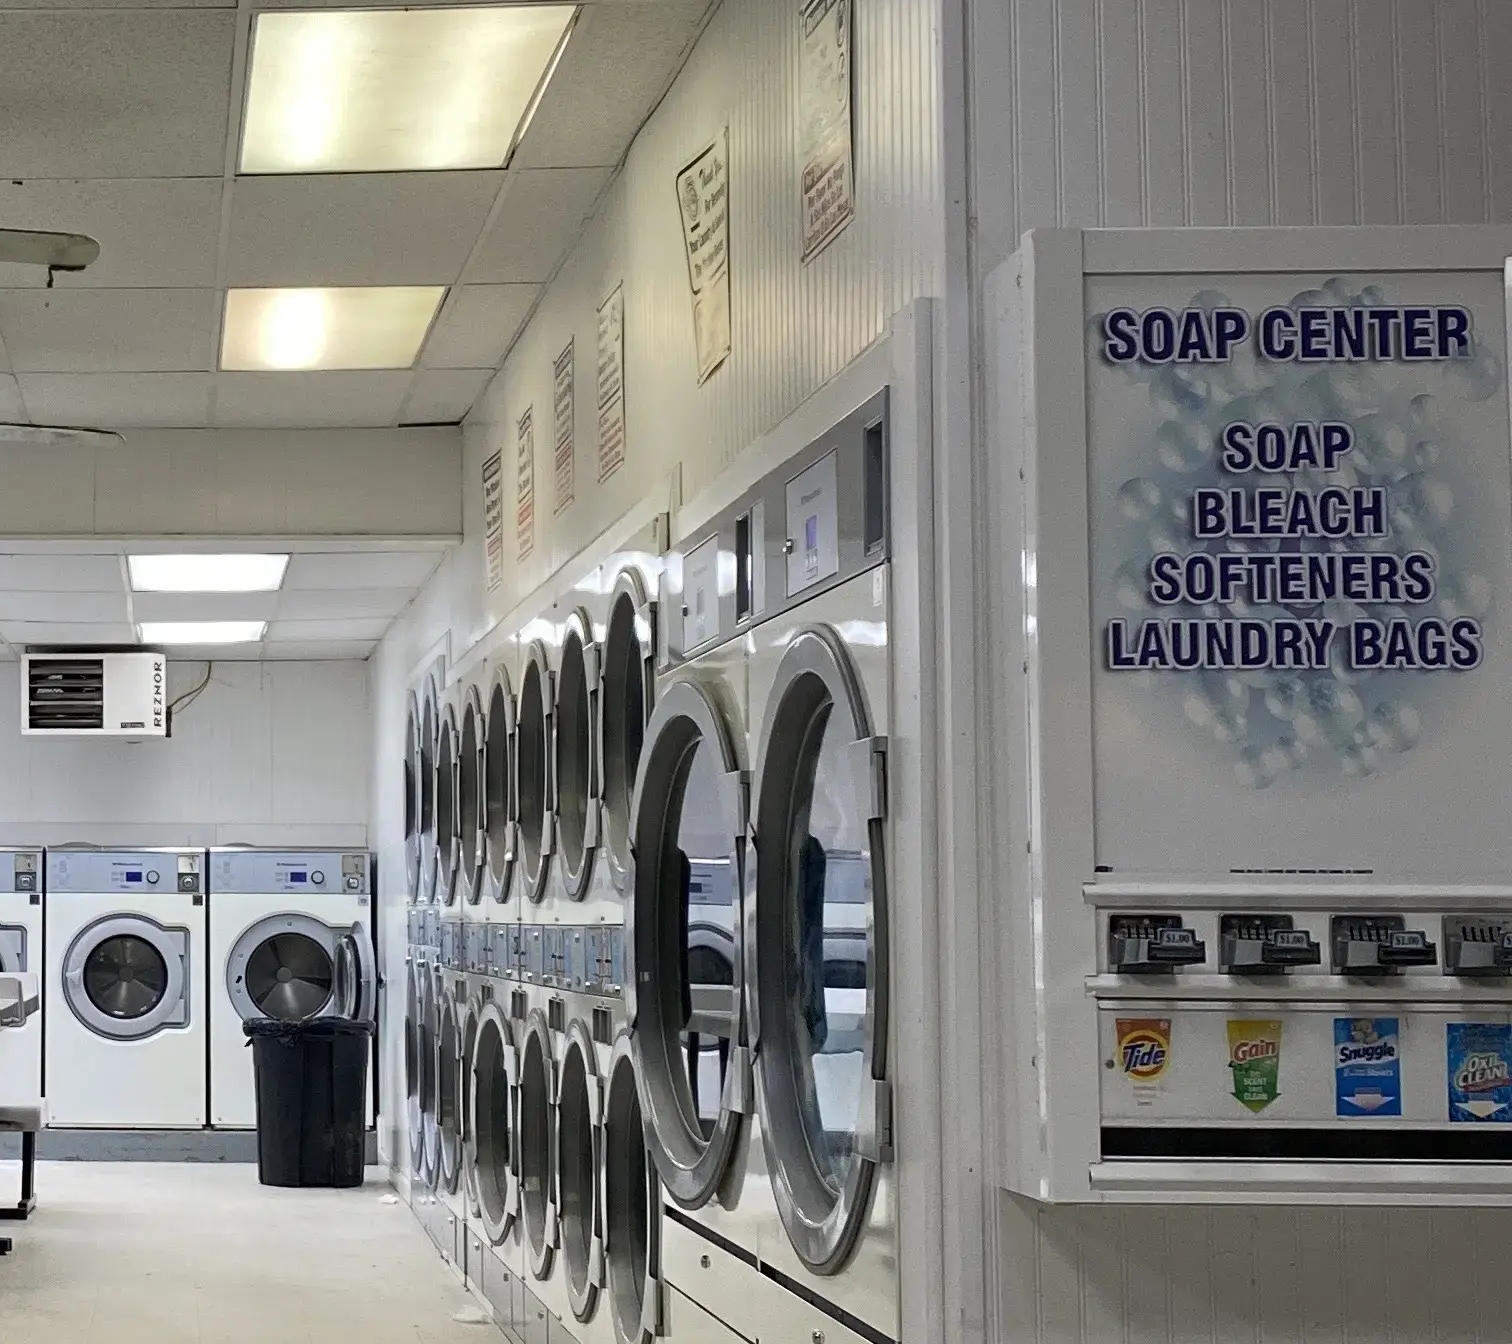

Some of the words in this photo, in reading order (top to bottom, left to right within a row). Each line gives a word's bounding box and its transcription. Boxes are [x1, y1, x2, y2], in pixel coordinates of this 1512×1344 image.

[1105, 309, 1248, 362] SOAP
[1261, 306, 1470, 360] CENTER
[1223, 423, 1353, 472] SOAP
[1196, 488, 1385, 537] BLEACH
[1152, 553, 1434, 602] SOFTENERS
[1108, 620, 1335, 668] LAUNDRY
[1350, 619, 1483, 668] BAGS
[153, 661, 163, 728] REZNOR
[1165, 933, 1190, 944] $1.00
[1279, 933, 1305, 945] $1.00
[1395, 935, 1420, 946] $1.00
[1122, 1042, 1167, 1073] Tide
[1233, 1040, 1278, 1063] Gain
[1339, 1042, 1395, 1063] Snuggle
[1468, 1057, 1493, 1072] OXI
[1458, 1066, 1504, 1087] CLEAN
